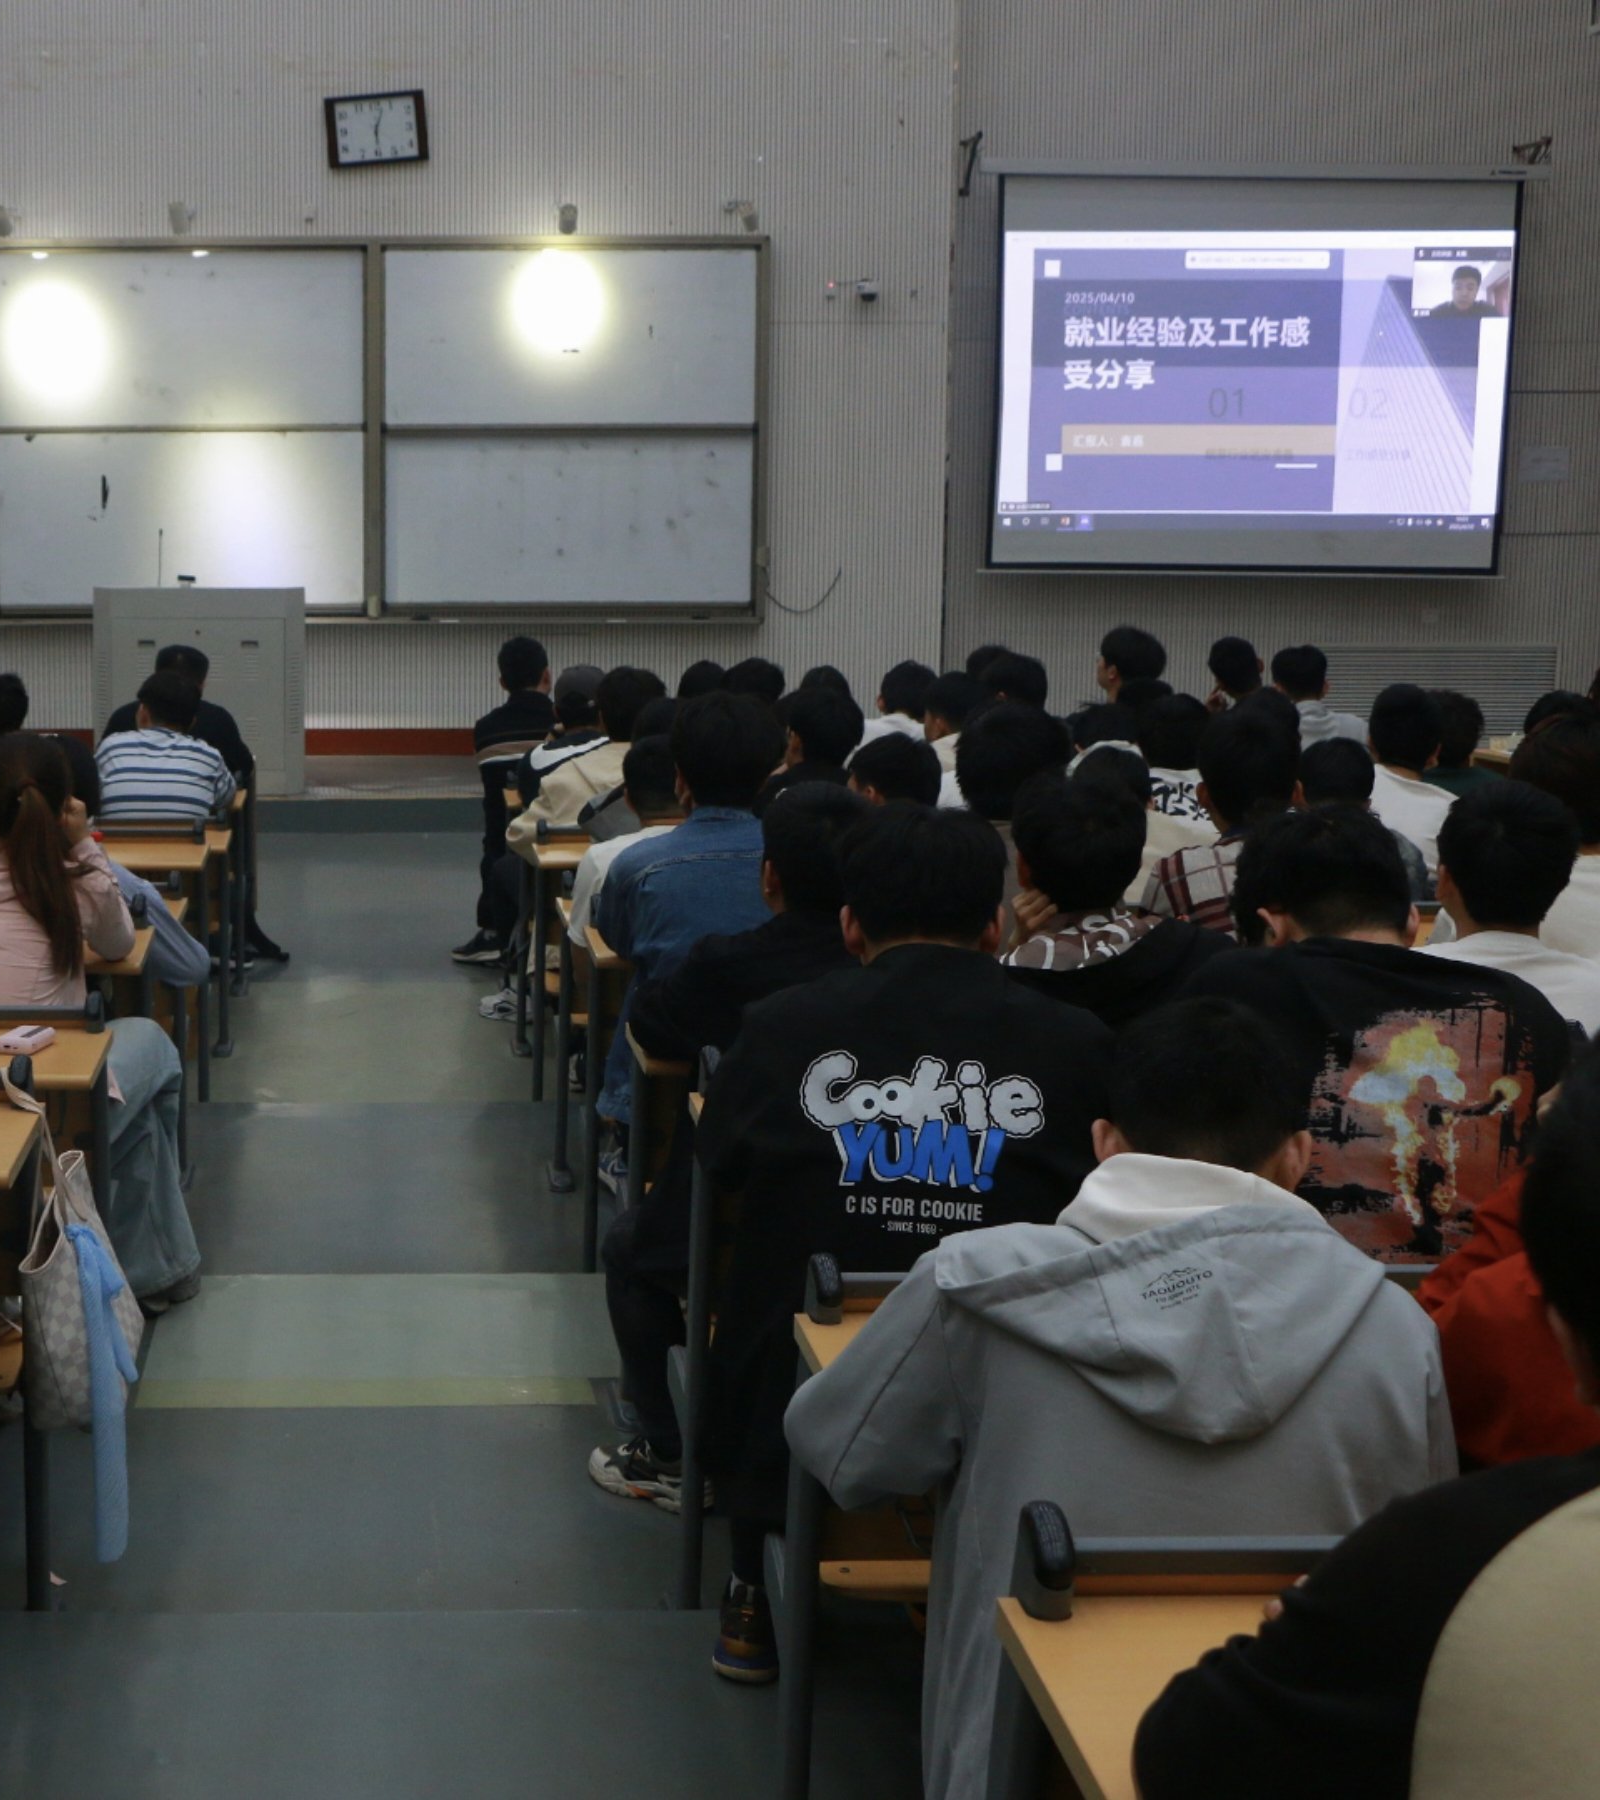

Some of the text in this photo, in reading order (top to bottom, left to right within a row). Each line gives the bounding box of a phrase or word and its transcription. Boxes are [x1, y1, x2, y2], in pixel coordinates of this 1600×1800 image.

[1065, 292, 1135, 304] 2025/04/10
[1063, 316, 1311, 348] 就业经验及工作感
[1063, 358, 1155, 391] 受分享
[1207, 387, 1246, 419] 01
[800, 1050, 1045, 1139] Cookie
[833, 1119, 1008, 1193] YUM!
[845, 1195, 984, 1222] C IS FOR COOKIE
[887, 1220, 913, 1233] SINCE
